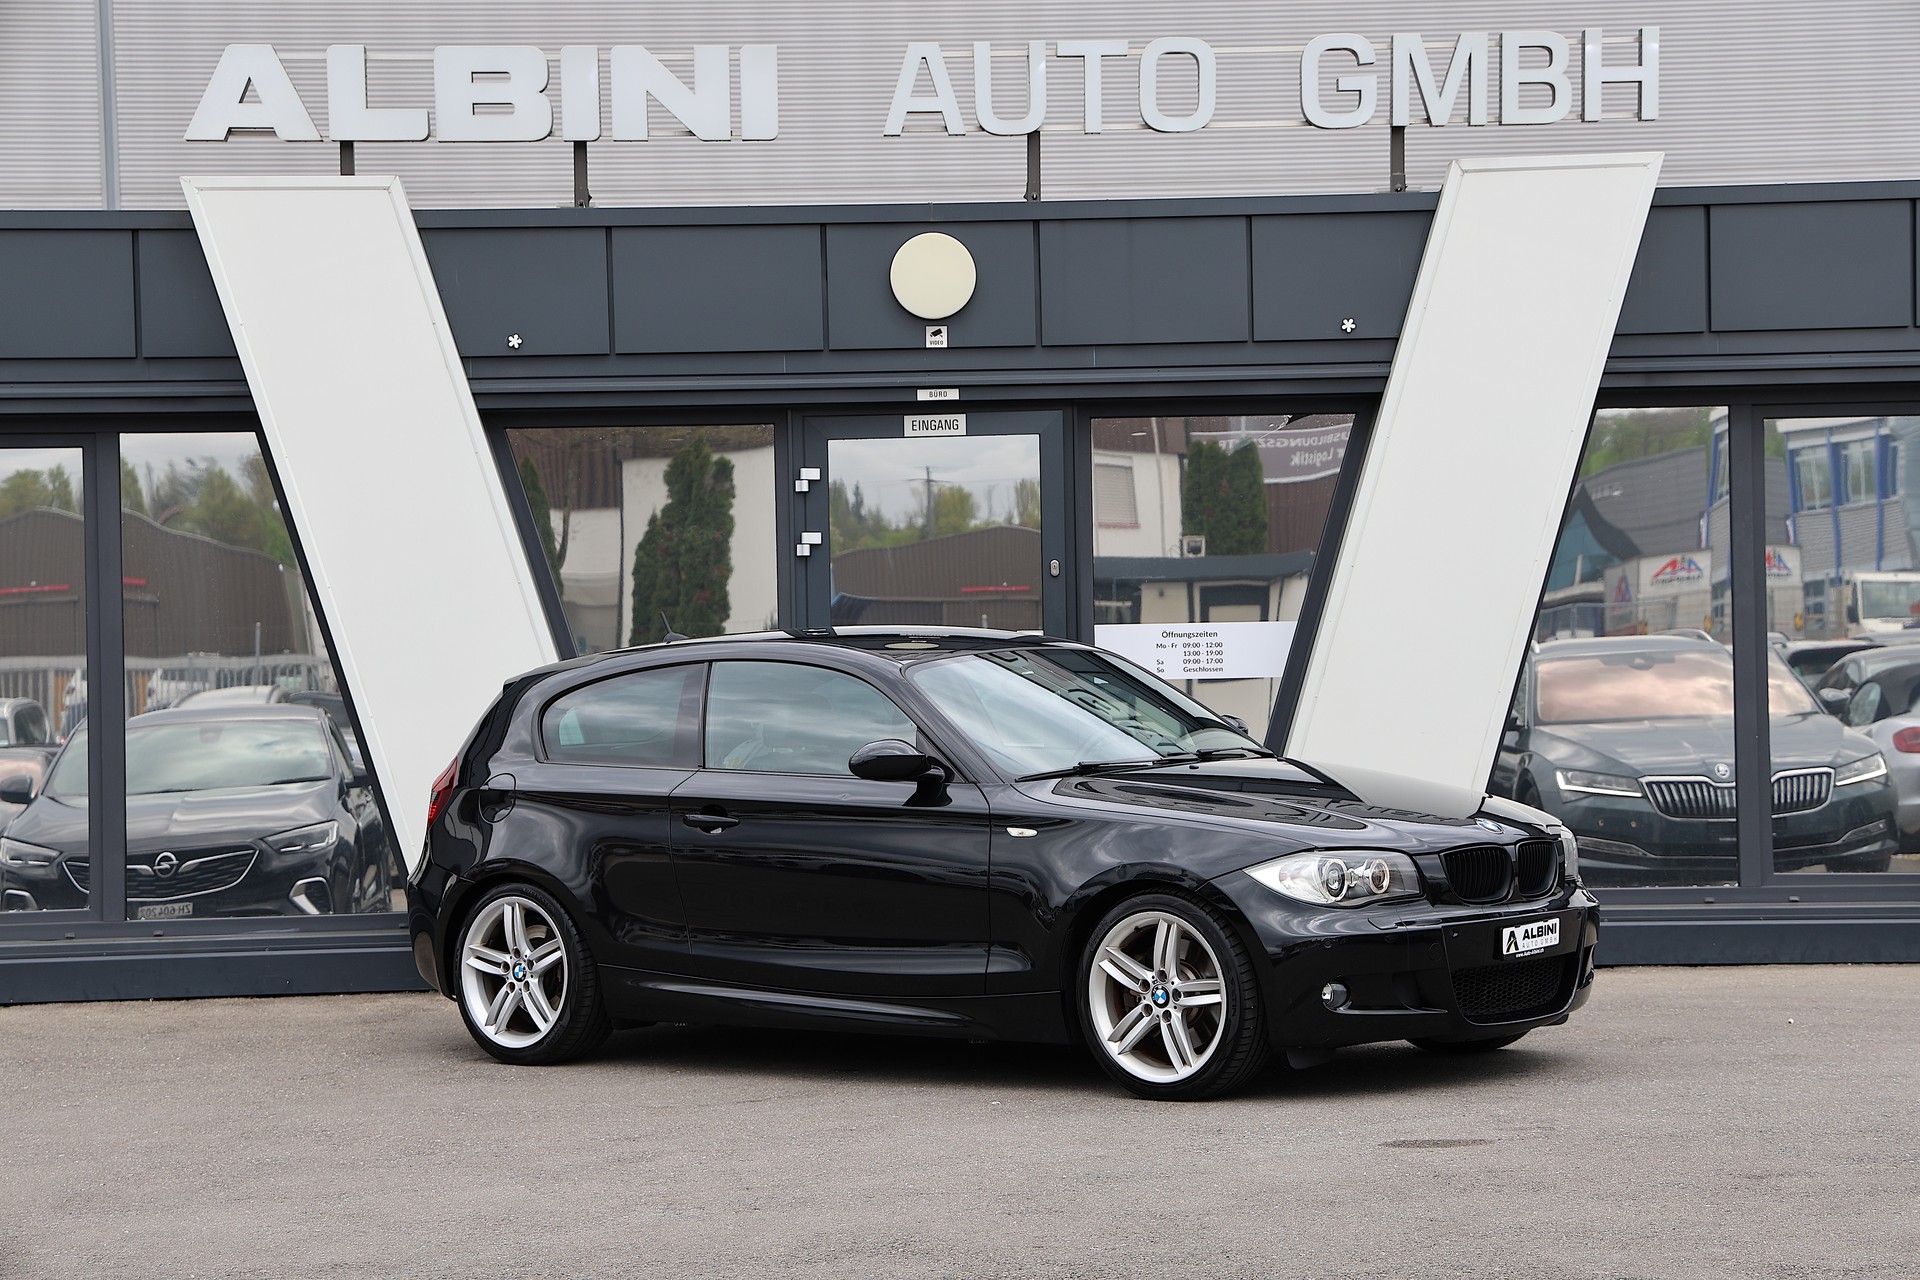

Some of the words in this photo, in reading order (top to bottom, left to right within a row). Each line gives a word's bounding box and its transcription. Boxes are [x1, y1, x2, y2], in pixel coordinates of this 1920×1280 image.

[184, 44, 779, 142] ALBINI
[883, 36, 1218, 137] AUTO
[1300, 26, 1661, 130] GMBH
[928, 390, 948, 398] BÜRO
[911, 418, 959, 431] EINGANG
[1161, 630, 1218, 639] Öffnungszeiten
[1522, 923, 1557, 940] ALBINI
[1522, 940, 1539, 949] AUTO
